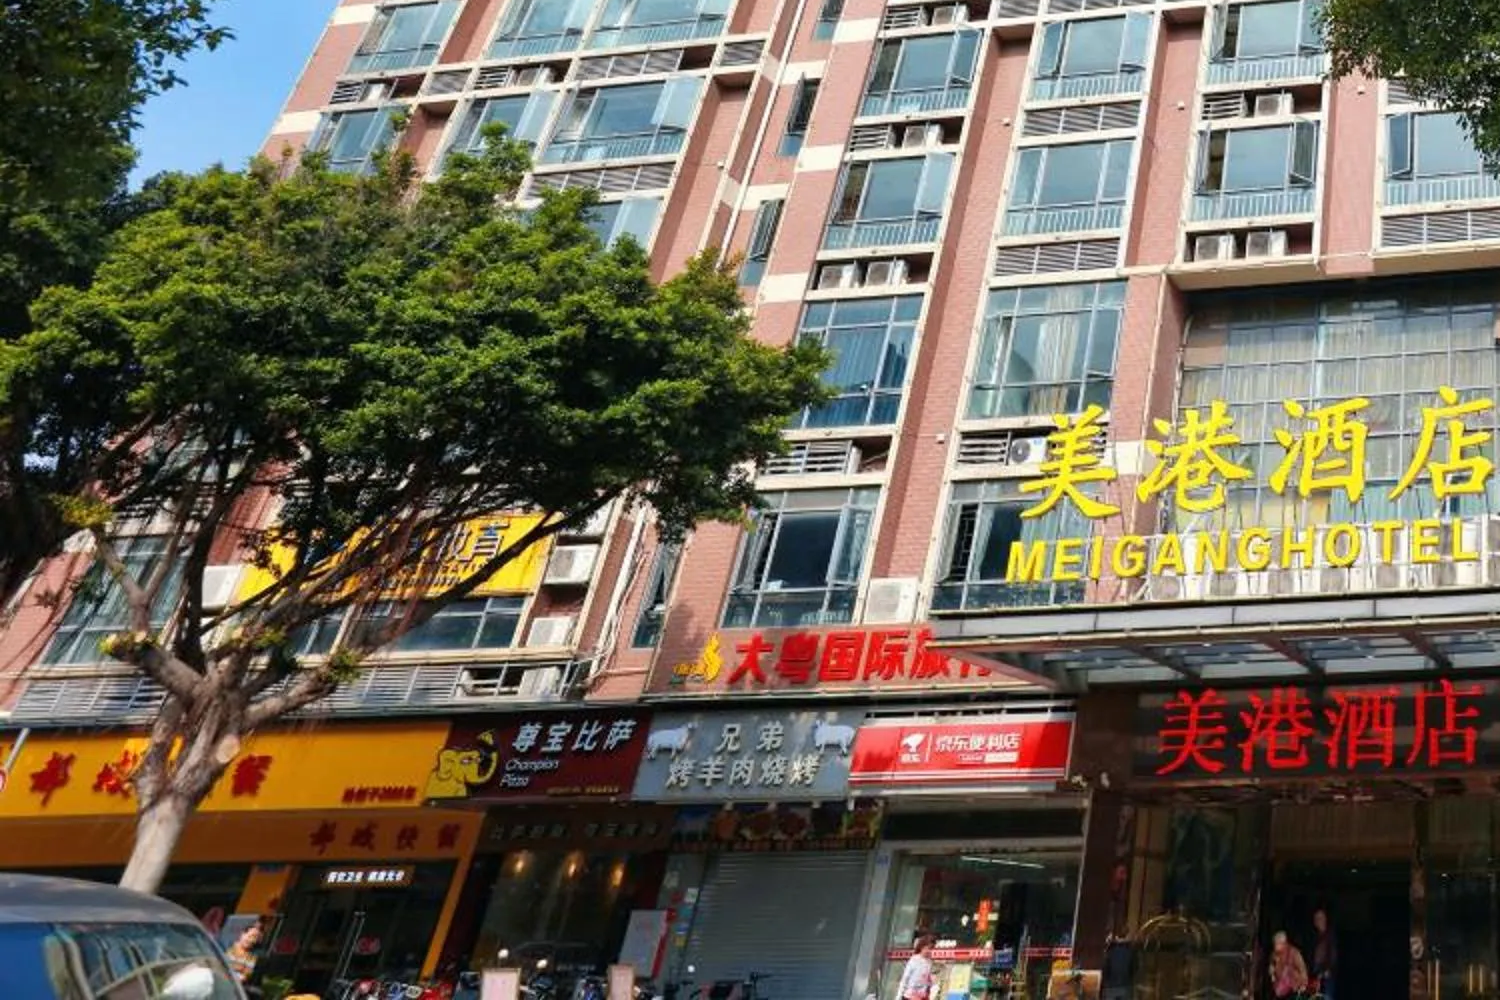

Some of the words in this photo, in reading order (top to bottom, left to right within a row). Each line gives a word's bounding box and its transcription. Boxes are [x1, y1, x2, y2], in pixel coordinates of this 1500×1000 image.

[1018, 386, 1496, 520] 美港酒店
[511, 718, 637, 753] 尊宝比萨
[715, 721, 785, 752] 兄弟
[934, 733, 1021, 752] 京东便利店
[1155, 678, 1485, 776] 美港酒店
[29, 751, 274, 808] 都城餐
[499, 773, 529, 787] Pizza
[505, 758, 560, 771] Champion
[665, 755, 821, 789] 烤羊肉烧烤
